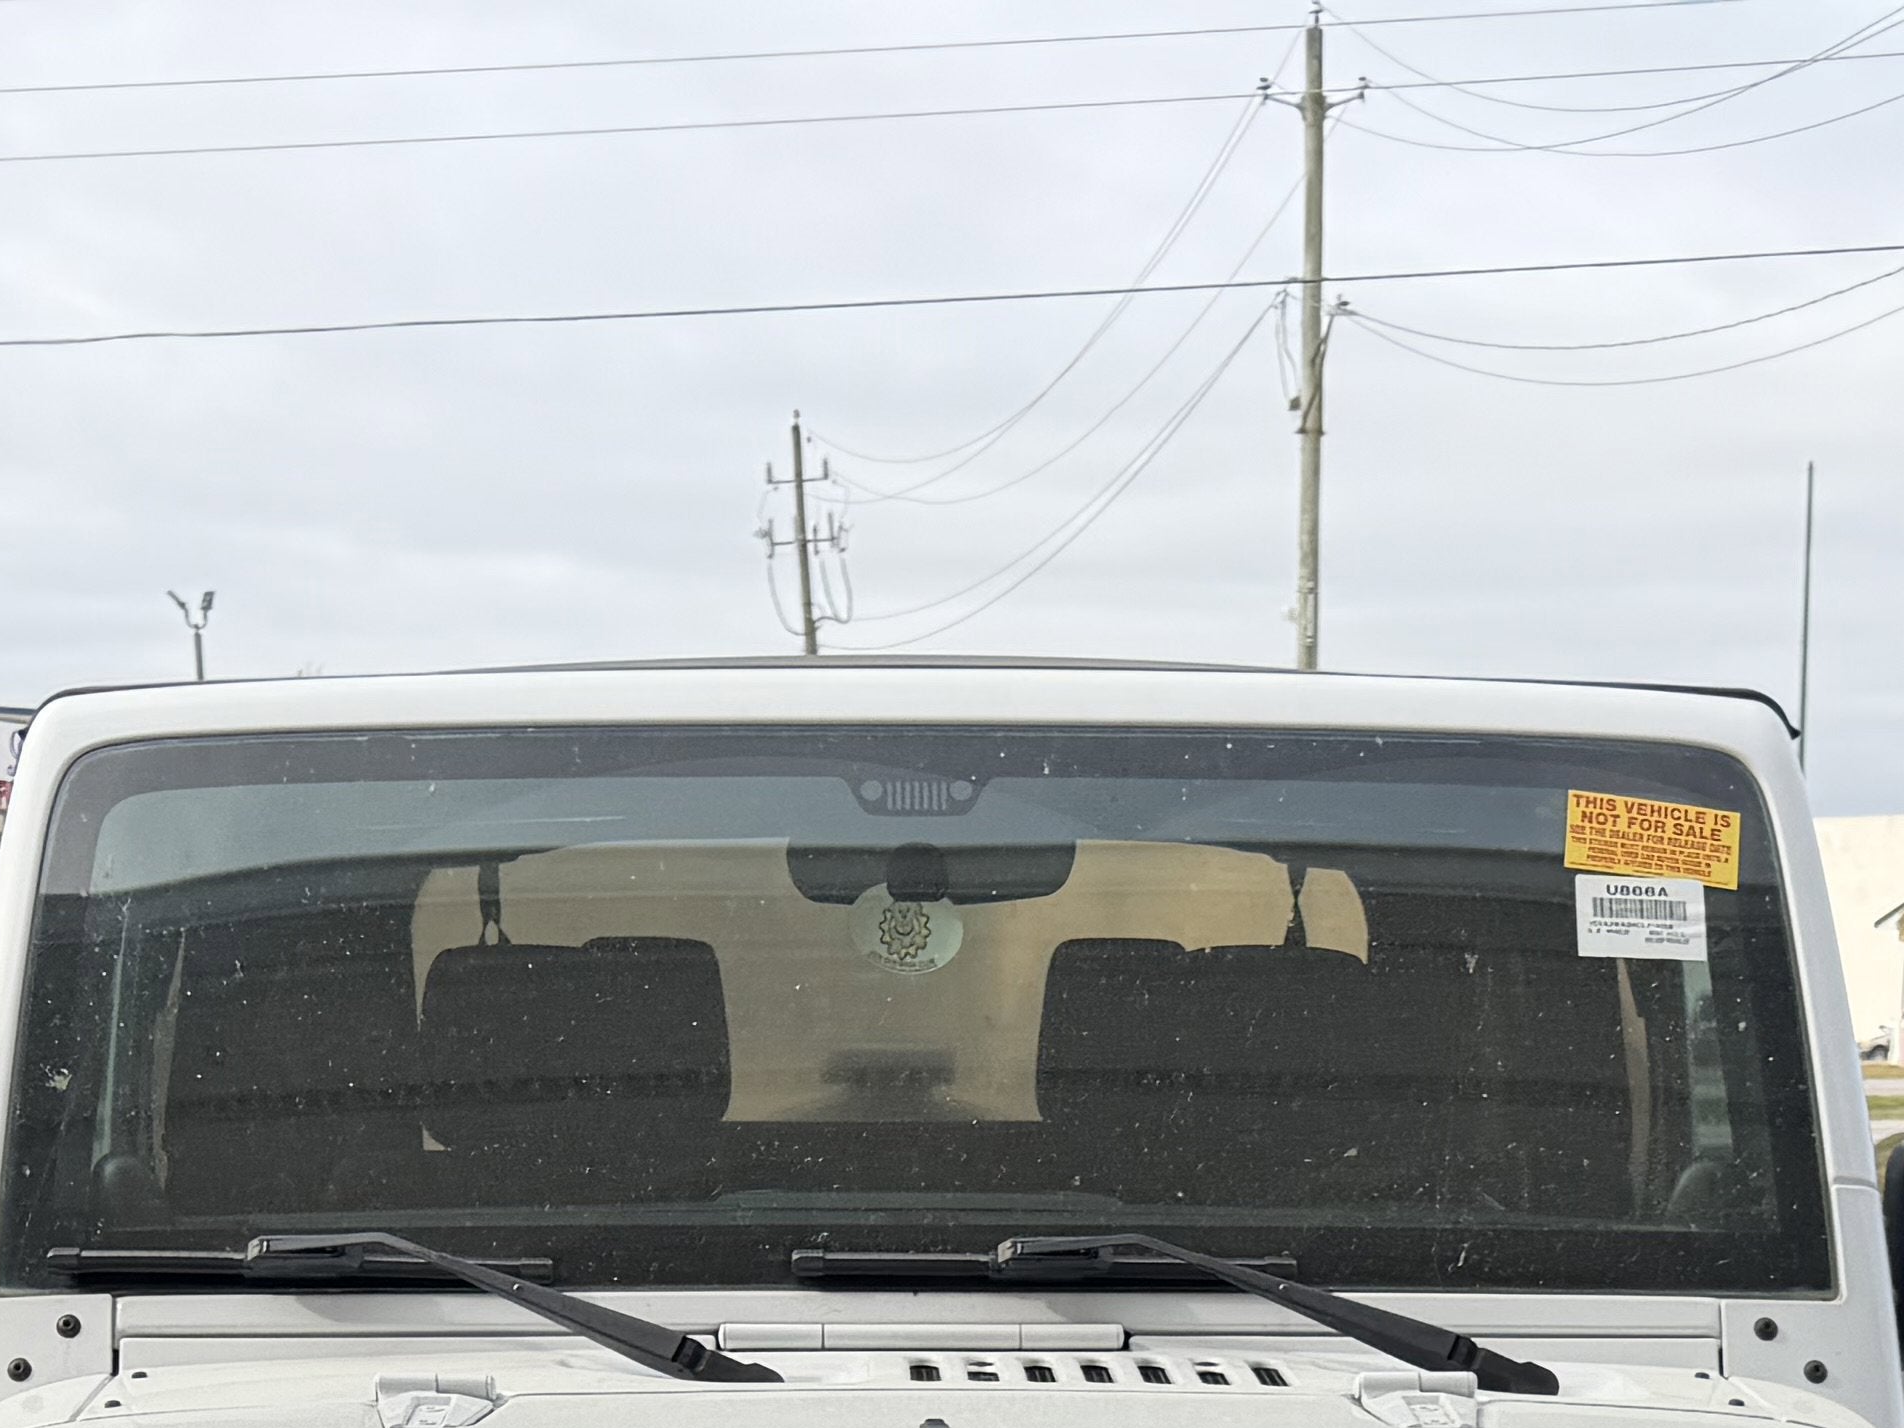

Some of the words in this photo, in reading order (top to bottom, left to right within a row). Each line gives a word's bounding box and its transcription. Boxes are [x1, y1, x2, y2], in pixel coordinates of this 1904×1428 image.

[1572, 794, 1617, 812] THIS
[1624, 800, 1707, 825] VEHICLE
[1714, 813, 1731, 828] IS
[1581, 811, 1621, 827] NOT
[1627, 816, 1666, 834] FOR
[1672, 822, 1722, 842] SALE
